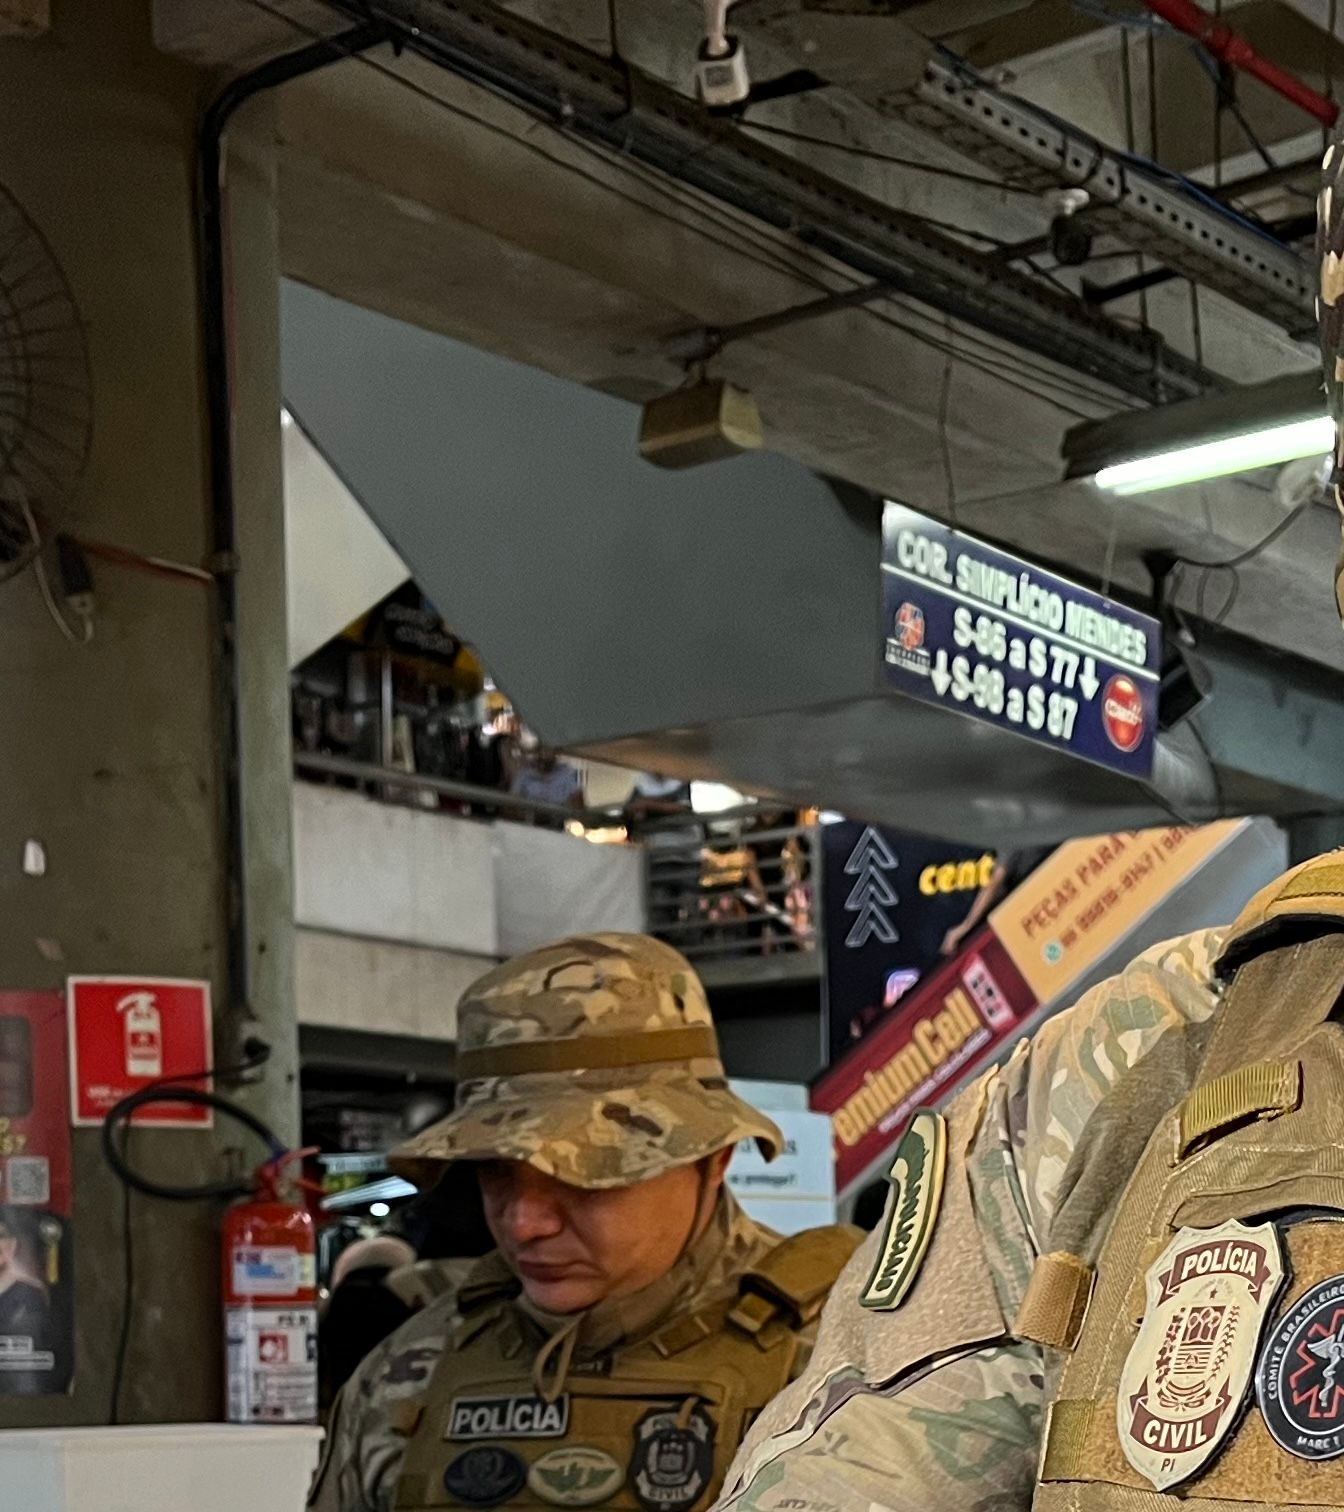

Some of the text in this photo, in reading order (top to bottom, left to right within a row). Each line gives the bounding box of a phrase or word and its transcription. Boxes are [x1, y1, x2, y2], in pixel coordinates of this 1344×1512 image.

[897, 530, 953, 584] COR.
[1065, 600, 1147, 666] MENDES
[1181, 1241, 1257, 1281] POLÍCIA
[454, 1397, 561, 1434] POLÍCIA
[1143, 1419, 1207, 1449] CIVIL
[1160, 1458, 1176, 1472] PI
